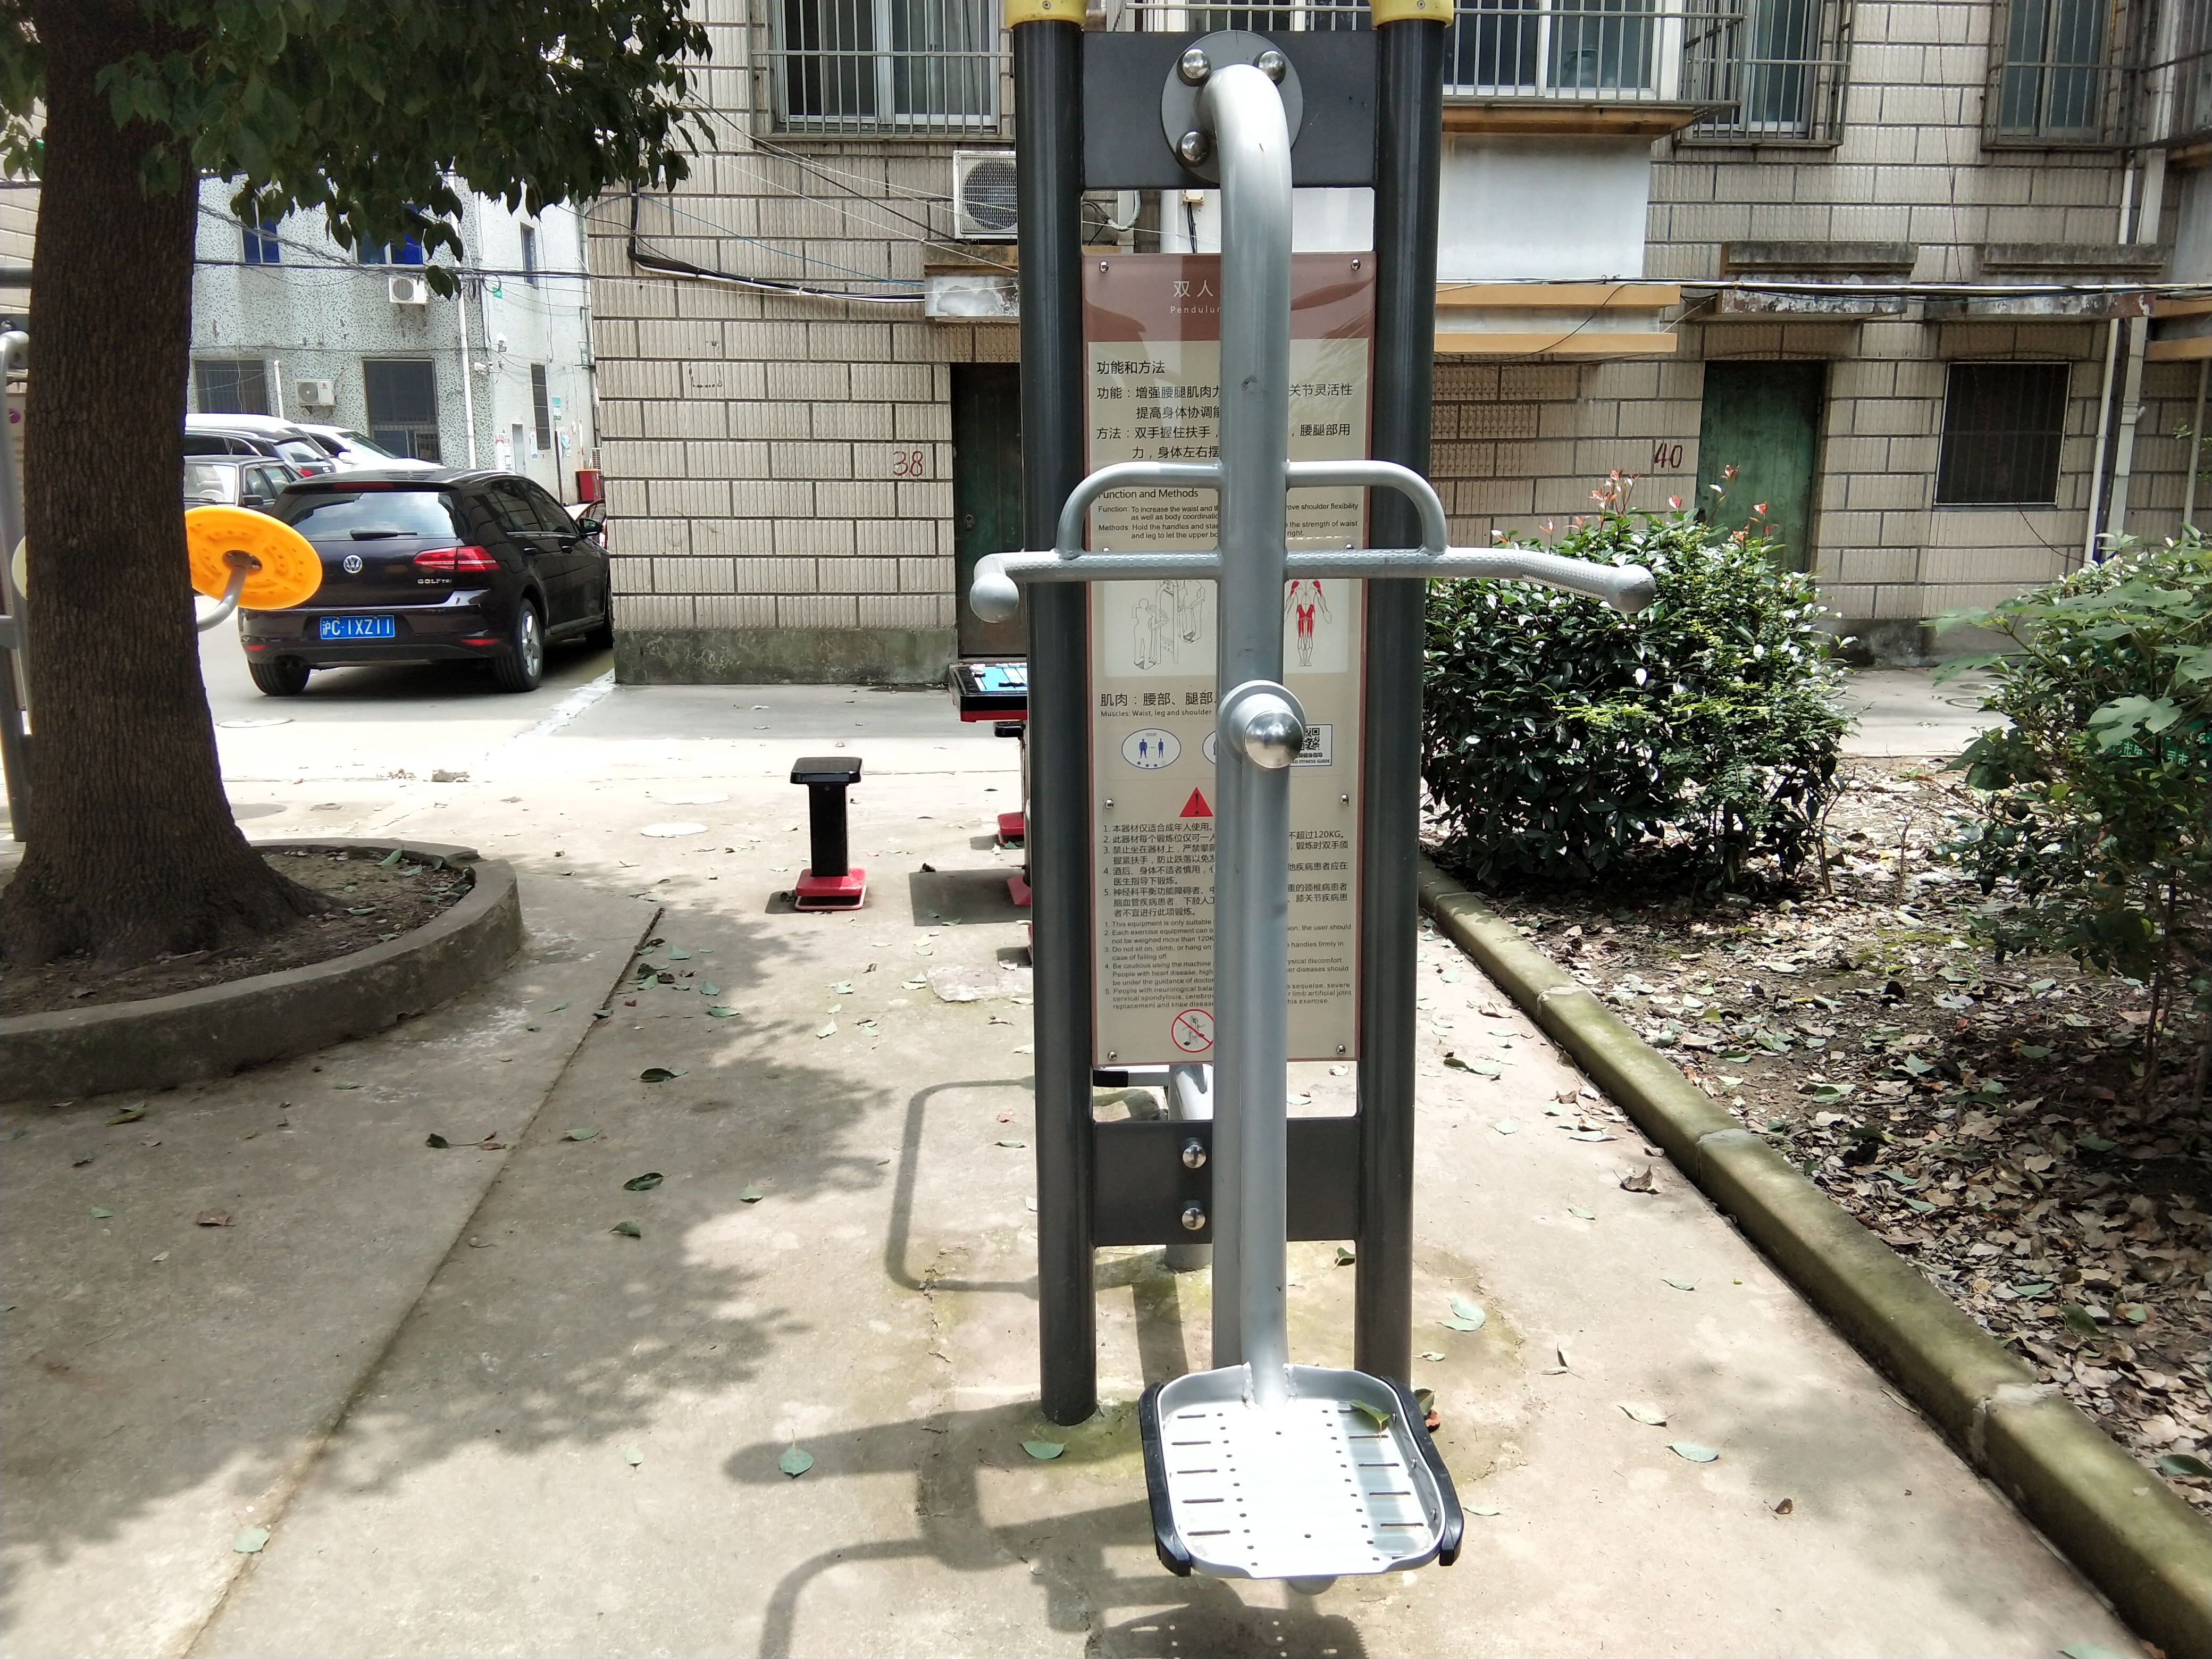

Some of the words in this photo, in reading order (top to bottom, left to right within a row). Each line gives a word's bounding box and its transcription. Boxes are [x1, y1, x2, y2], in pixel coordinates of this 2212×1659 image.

[1174, 280, 1213, 298] 双人
[1096, 360, 1166, 375] 功能和方法
[1289, 383, 1353, 396] 关节灵活性
[1654, 442, 1683, 468] 40
[893, 450, 924, 477] 38
[1139, 489, 1157, 499] and
[1159, 488, 1199, 498] Methods
[1146, 532, 1157, 540] leg
